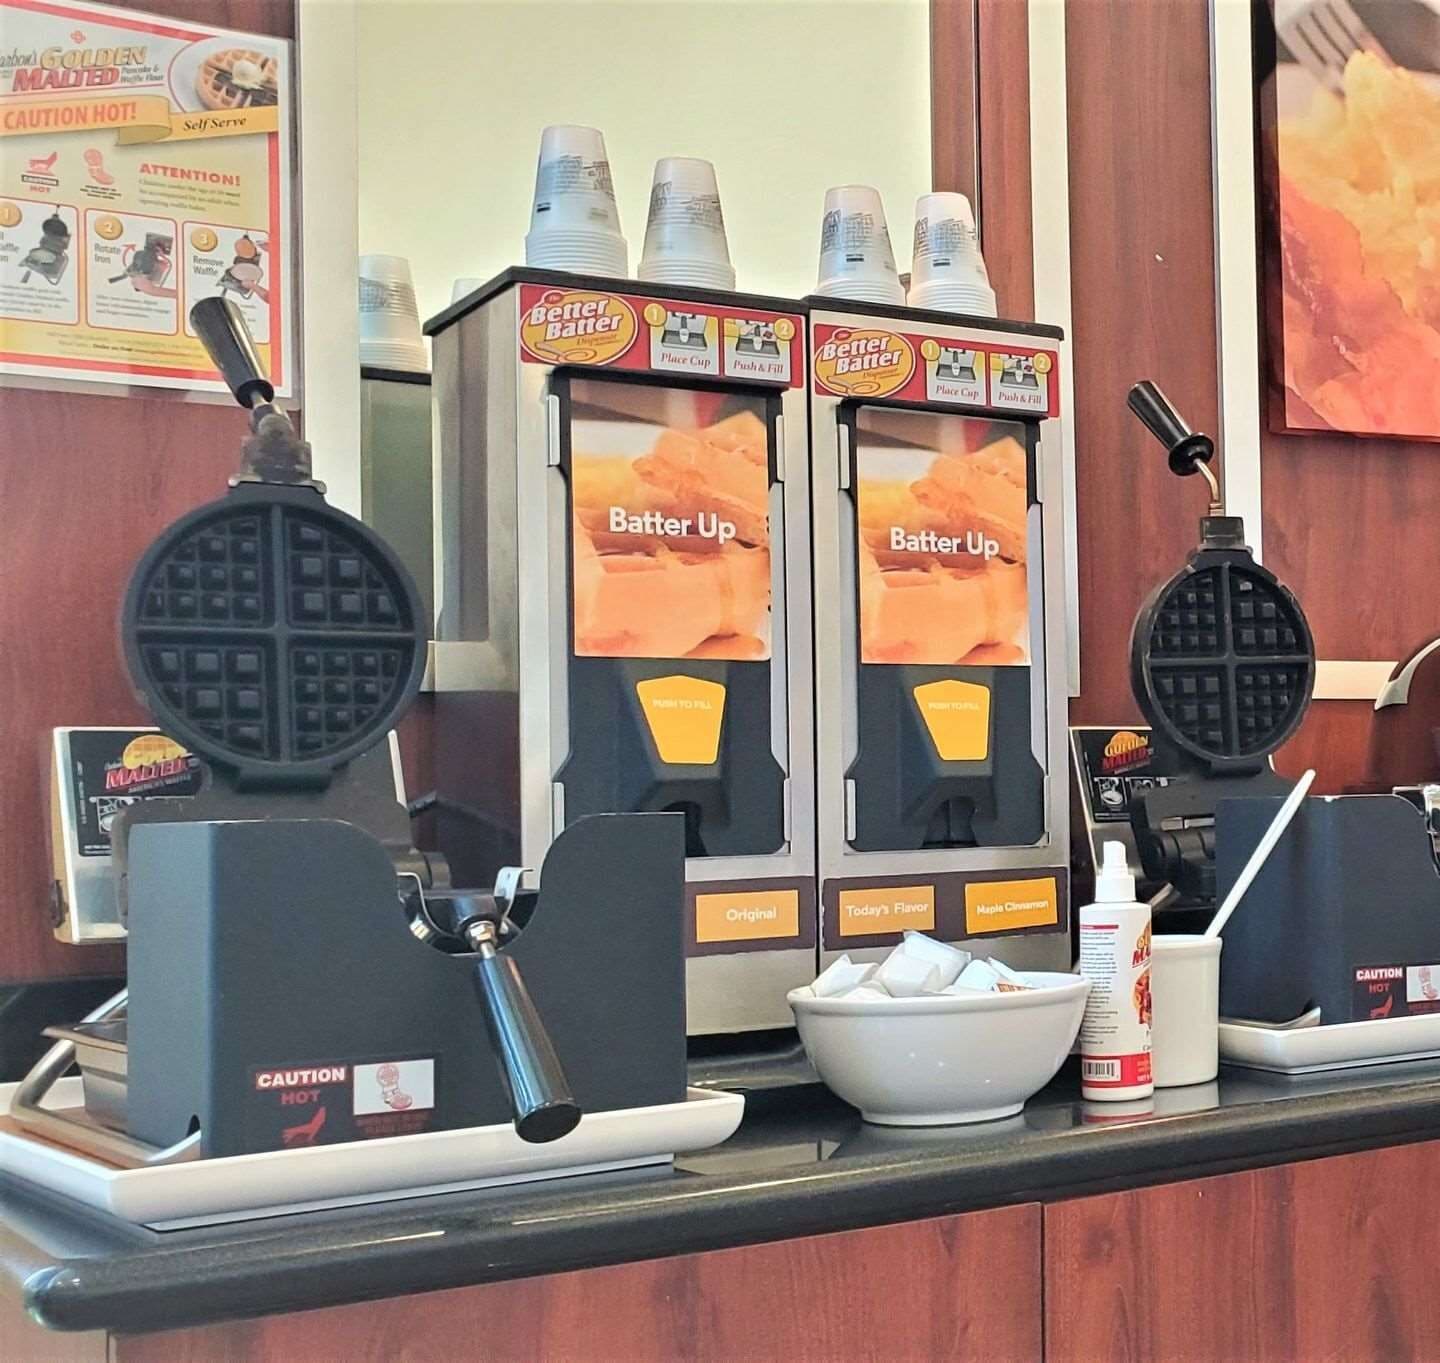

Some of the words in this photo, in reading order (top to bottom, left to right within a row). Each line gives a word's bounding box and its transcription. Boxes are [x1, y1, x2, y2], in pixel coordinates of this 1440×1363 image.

[40, 46, 148, 70] GOLDEN
[12, 67, 120, 91] MALTED
[4, 107, 88, 130] CAUTION
[94, 102, 137, 123] HOT!
[184, 118, 209, 132] Self
[210, 117, 247, 129] Serve
[139, 163, 241, 186] ATTENTION!
[104, 222, 113, 233] 2
[200, 233, 208, 244] 3
[530, 299, 609, 325] Better
[545, 314, 623, 340] Batter
[821, 335, 890, 361] Better
[661, 352, 688, 363] Place
[690, 355, 711, 369] Cup
[733, 359, 758, 371] Push
[758, 363, 765, 372] &
[767, 363, 784, 374] Fill
[835, 350, 903, 375] Batter
[936, 385, 958, 396] Place
[960, 387, 979, 400] Cup
[998, 391, 1019, 402] Push
[1020, 395, 1026, 403] &
[1028, 395, 1042, 404] Fill
[609, 506, 692, 536] Batter
[698, 511, 737, 544] Up
[890, 527, 961, 553] Batter
[966, 531, 1000, 560] Up
[679, 700, 692, 709] TO
[726, 906, 777, 924] Original
[846, 904, 889, 918] Today's
[894, 902, 929, 914] Flavor
[976, 903, 1003, 916] Maple
[1005, 900, 1049, 912] Cinnamon
[1356, 967, 1403, 981] CAUTION
[1369, 983, 1390, 993] HOT
[257, 1067, 345, 1088] CAUTION
[281, 1090, 320, 1105] HOT
